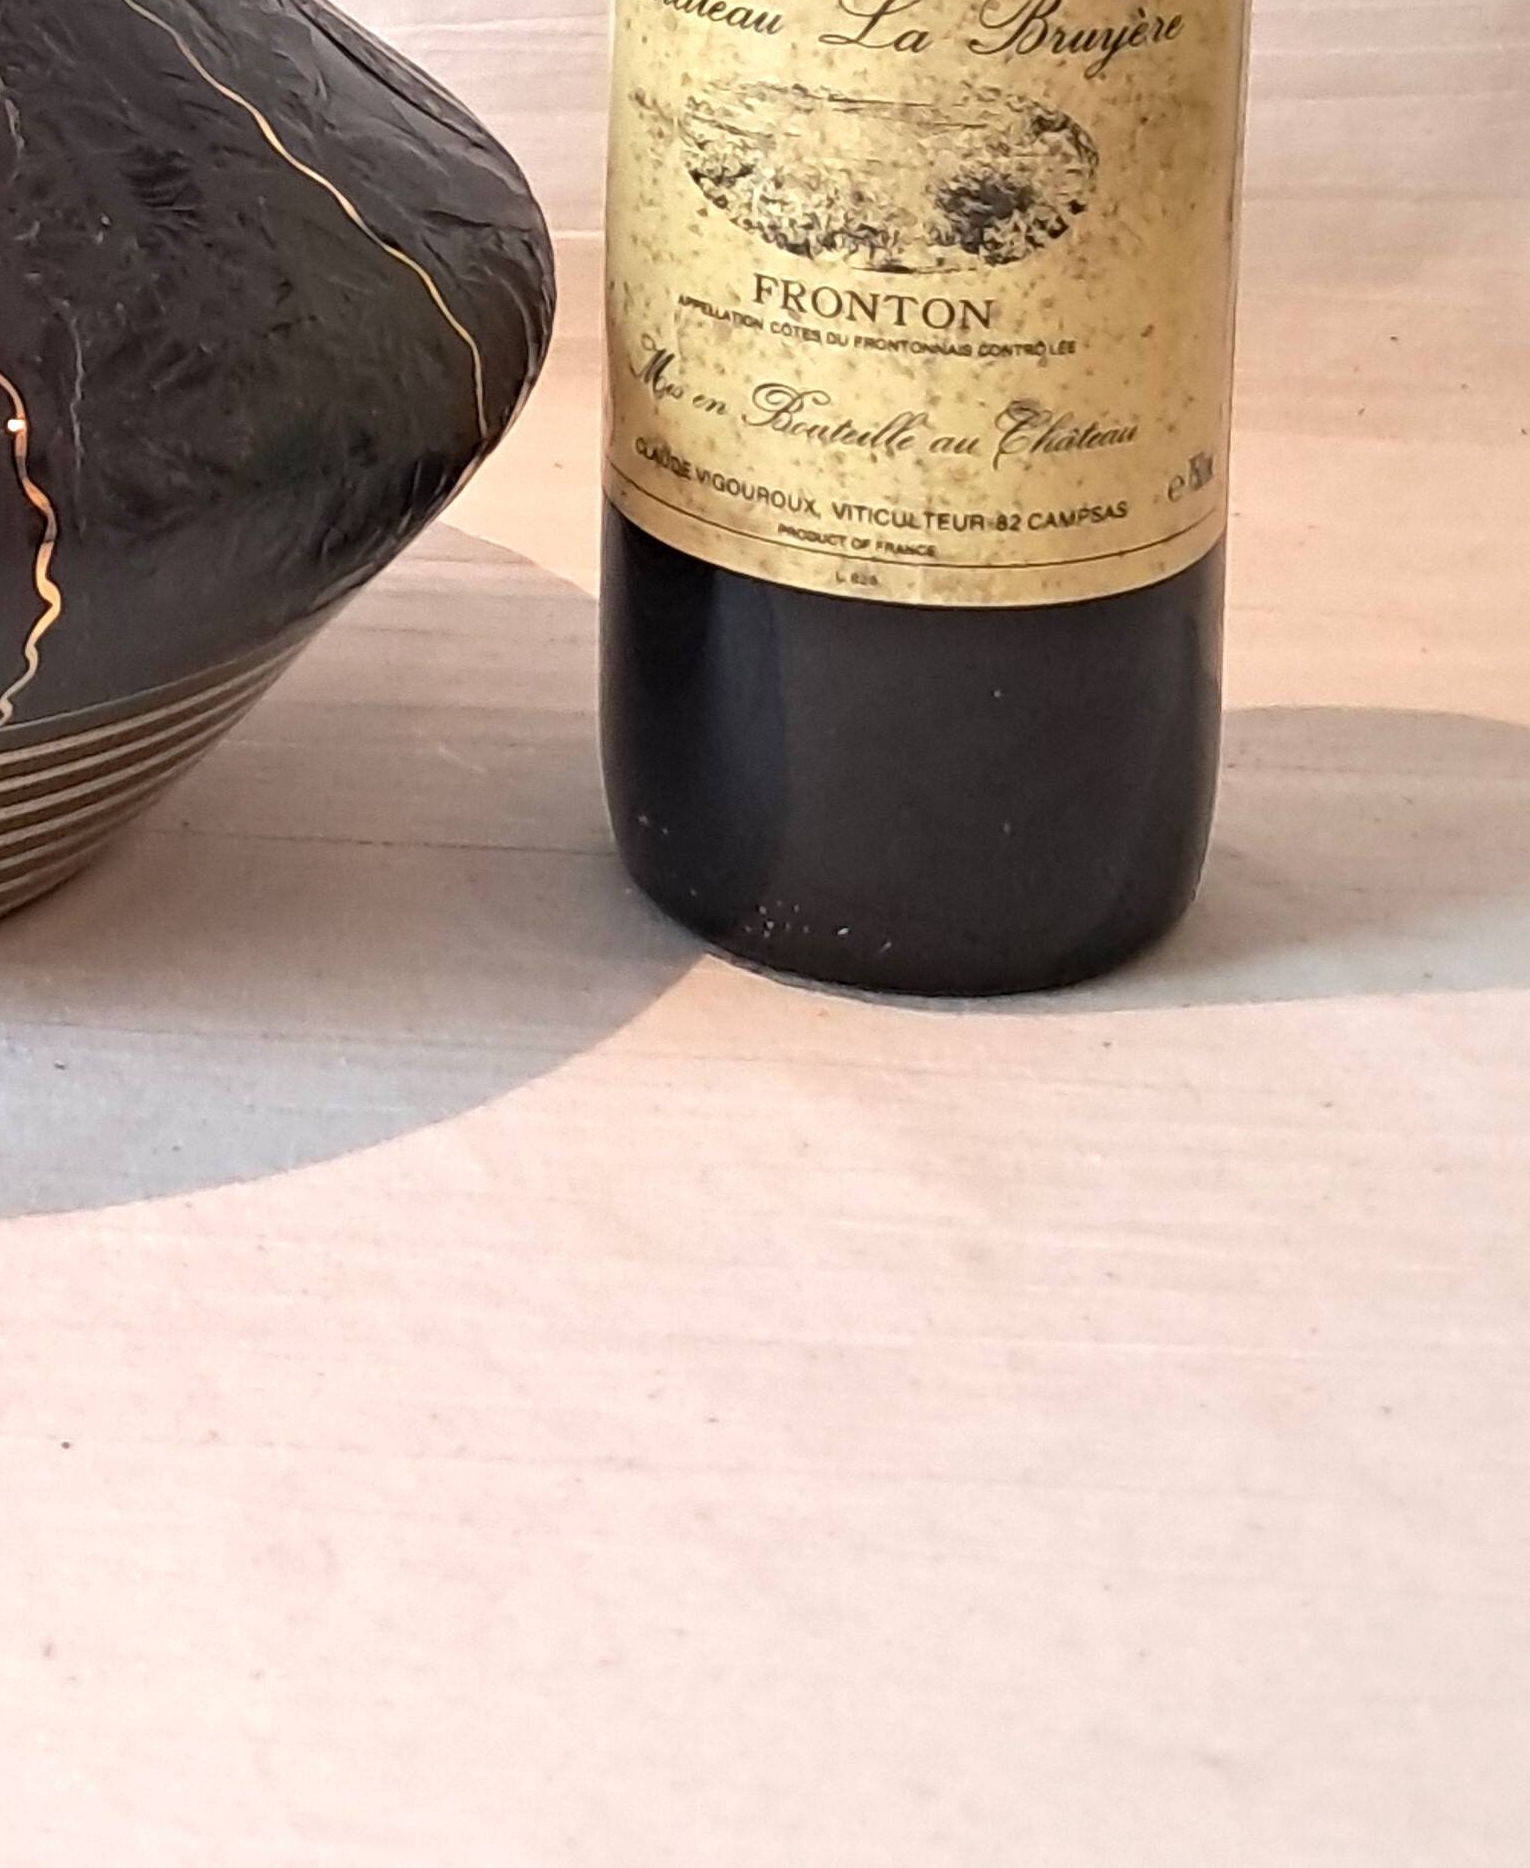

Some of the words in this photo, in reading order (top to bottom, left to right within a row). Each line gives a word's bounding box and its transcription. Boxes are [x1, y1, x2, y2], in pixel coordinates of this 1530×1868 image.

[678, 294, 763, 329] APPELLATION
[826, 332, 848, 347] DU
[853, 335, 972, 356] FRONTONNAIS
[752, 272, 994, 330] FRONTON
[629, 334, 684, 400] Mis
[691, 394, 727, 416] en
[741, 382, 936, 452] Bouteille
[928, 435, 981, 455] au
[634, 437, 691, 480] CLAUDE
[1027, 500, 1129, 531] CAMPSAS
[777, 523, 847, 547] PRODUCT
[851, 537, 870, 550] OF
[875, 540, 937, 557] FRANCE
